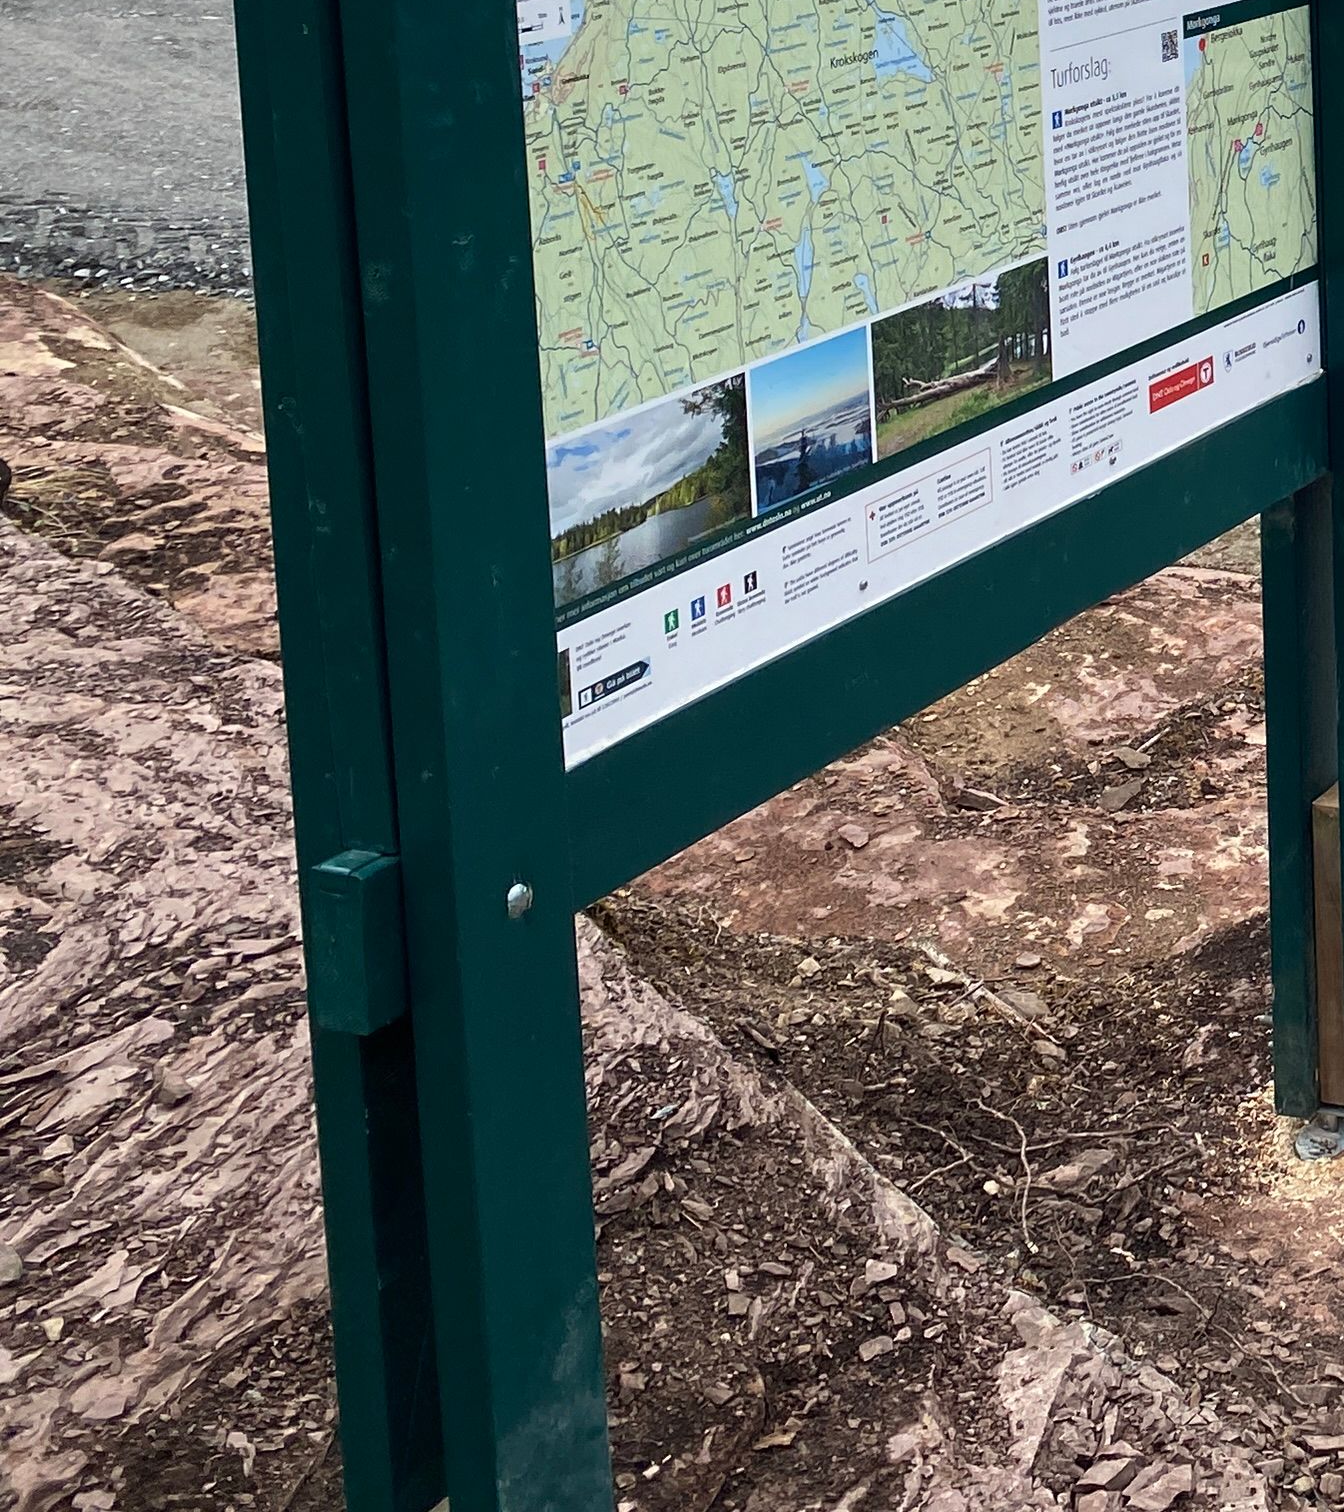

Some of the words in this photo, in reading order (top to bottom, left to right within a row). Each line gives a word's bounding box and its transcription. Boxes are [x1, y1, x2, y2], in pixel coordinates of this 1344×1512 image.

[1186, 12, 1220, 33] Mørkgonga
[830, 49, 878, 68] Krokskogen
[1051, 57, 1110, 87] Turforslag:
